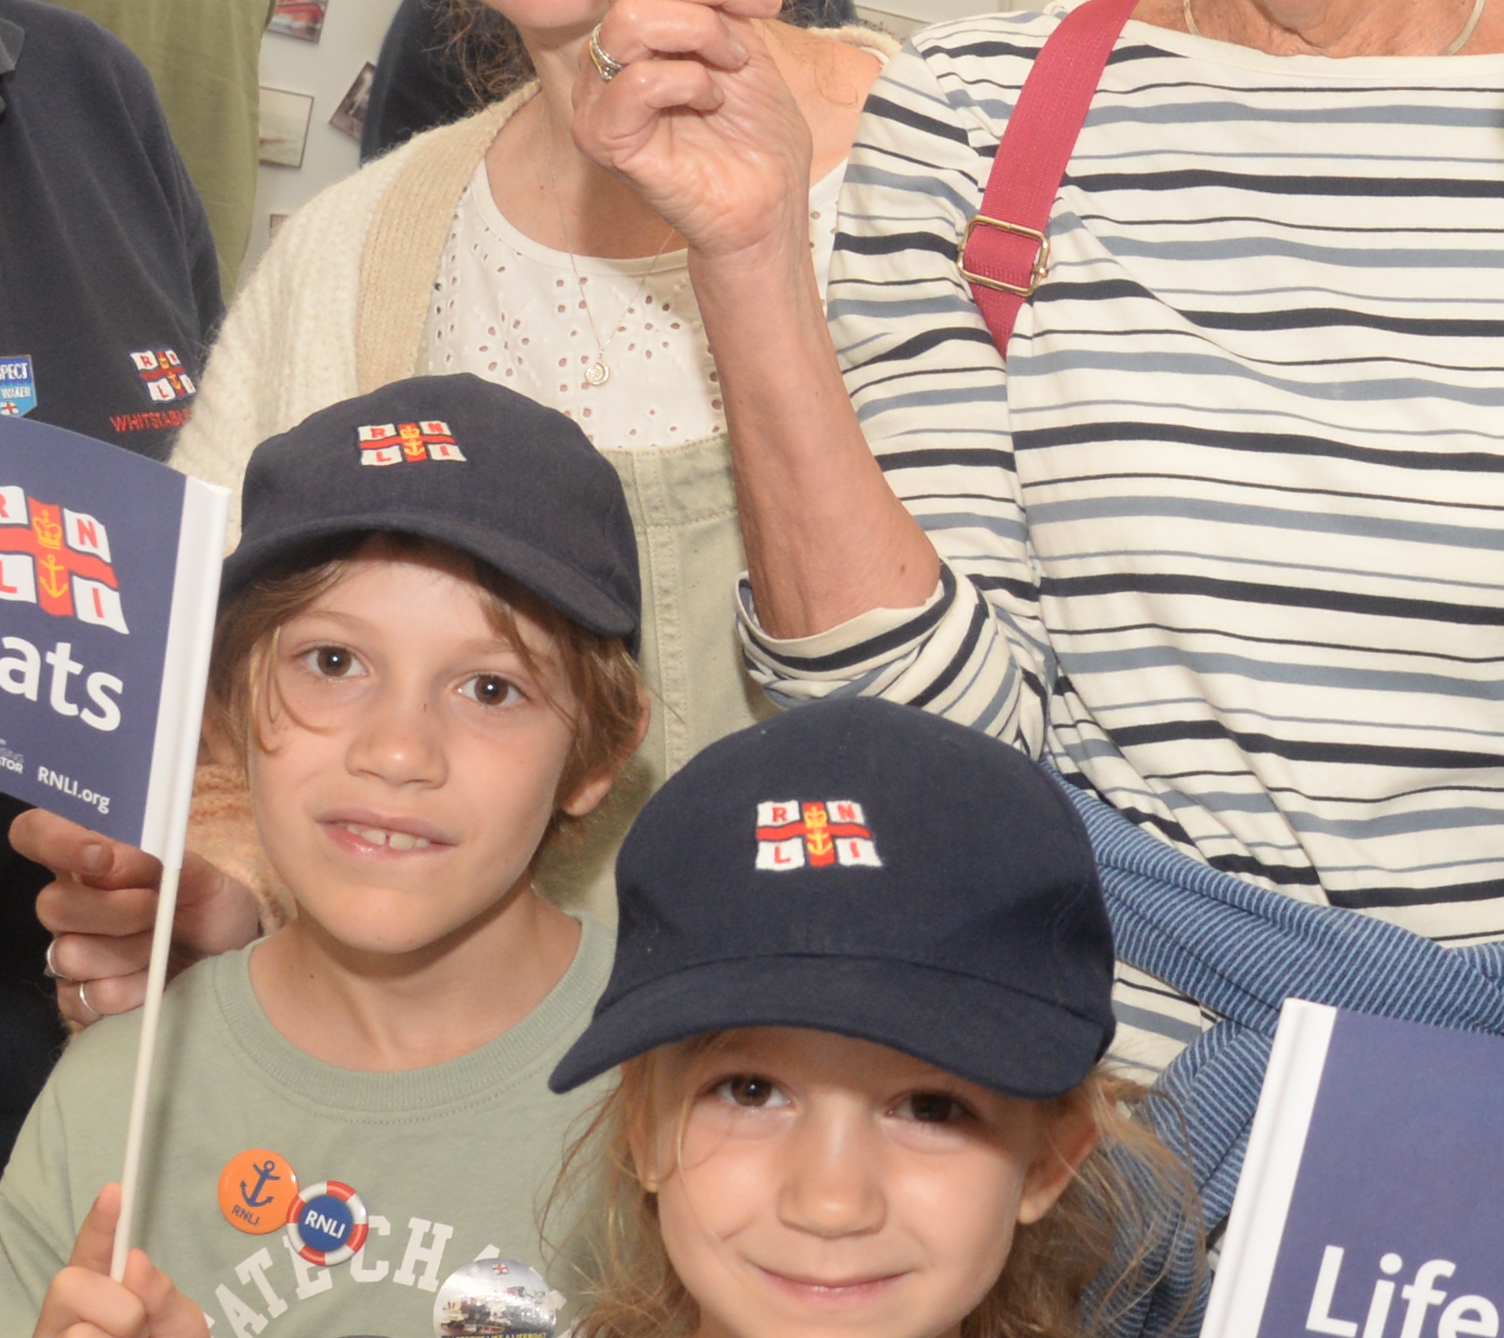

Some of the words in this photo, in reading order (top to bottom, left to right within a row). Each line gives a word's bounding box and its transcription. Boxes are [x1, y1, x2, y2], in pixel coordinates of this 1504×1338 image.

[37, 766, 110, 815] RNLI.org
[232, 1204, 260, 1227] RNLI
[304, 1210, 346, 1239] RNLI
